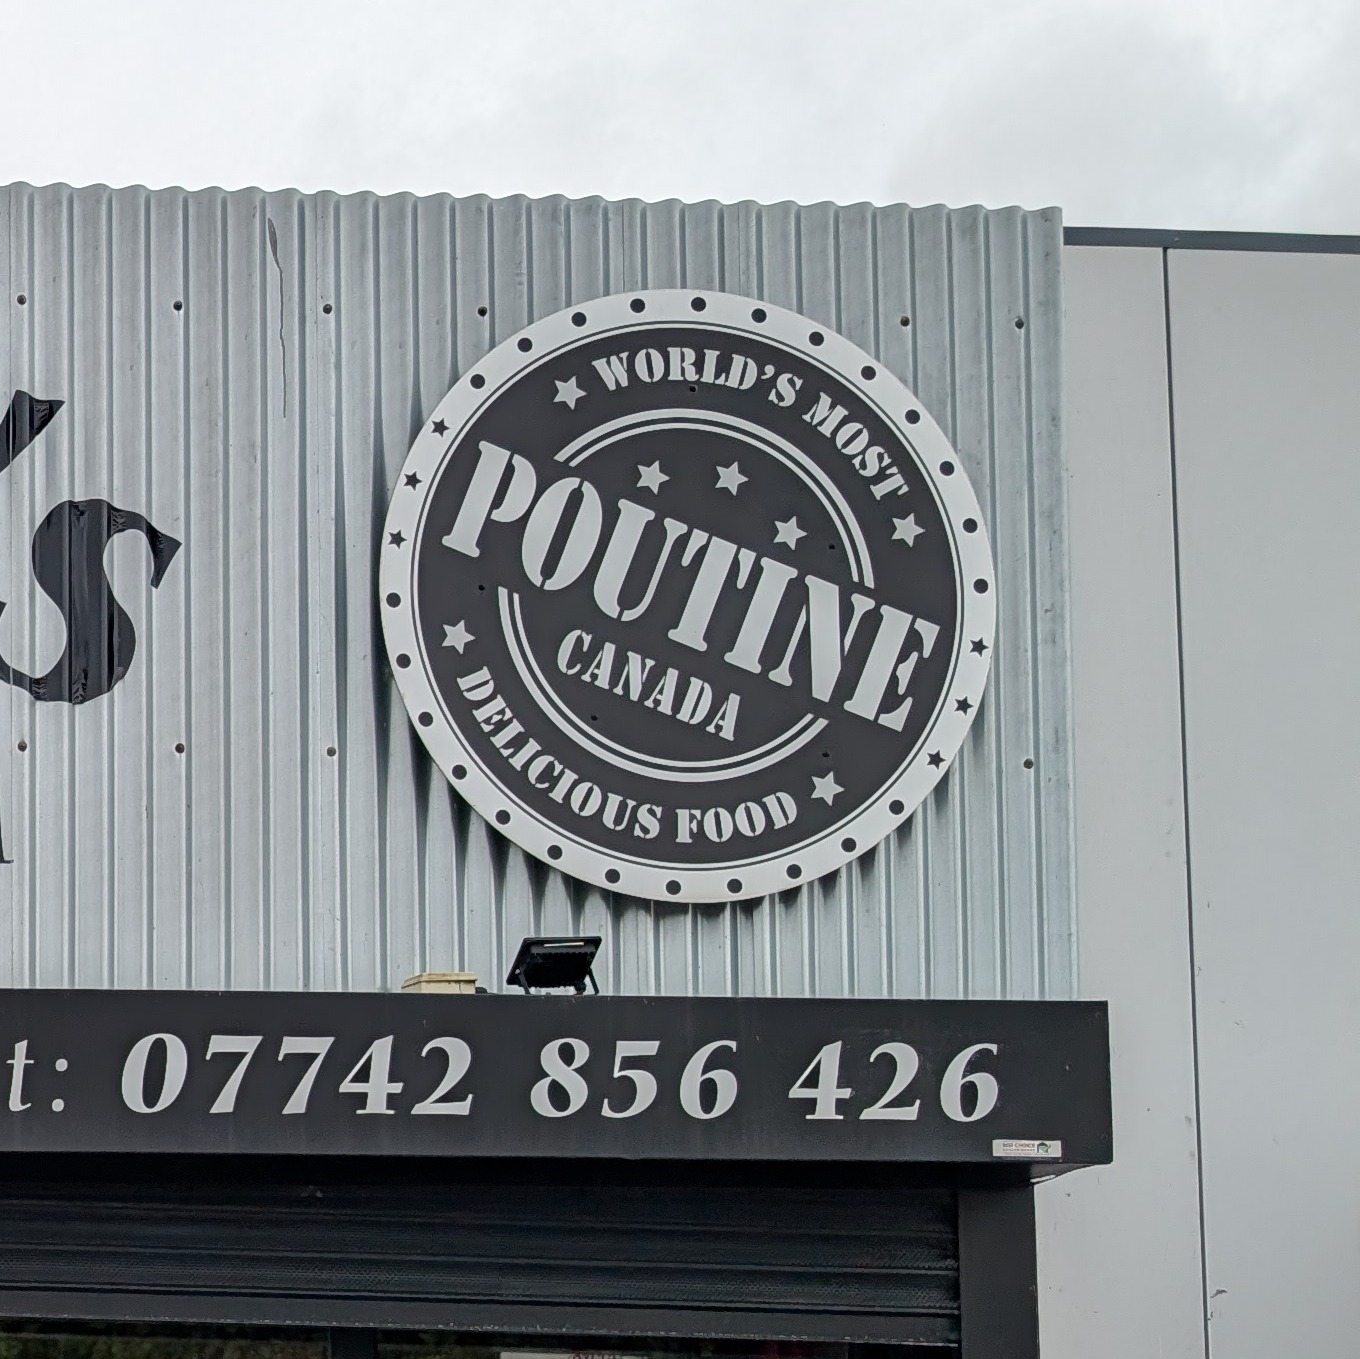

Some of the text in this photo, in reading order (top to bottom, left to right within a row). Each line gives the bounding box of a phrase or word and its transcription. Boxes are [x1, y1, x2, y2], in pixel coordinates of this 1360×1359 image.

[591, 346, 910, 501] WORLD'S MOST
[441, 440, 941, 733] POUTINE
[456, 665, 798, 844] DELICIOUS FOOD
[557, 628, 742, 742] CANADA
[5, 1031, 1000, 1124] t: 07742 856 426
